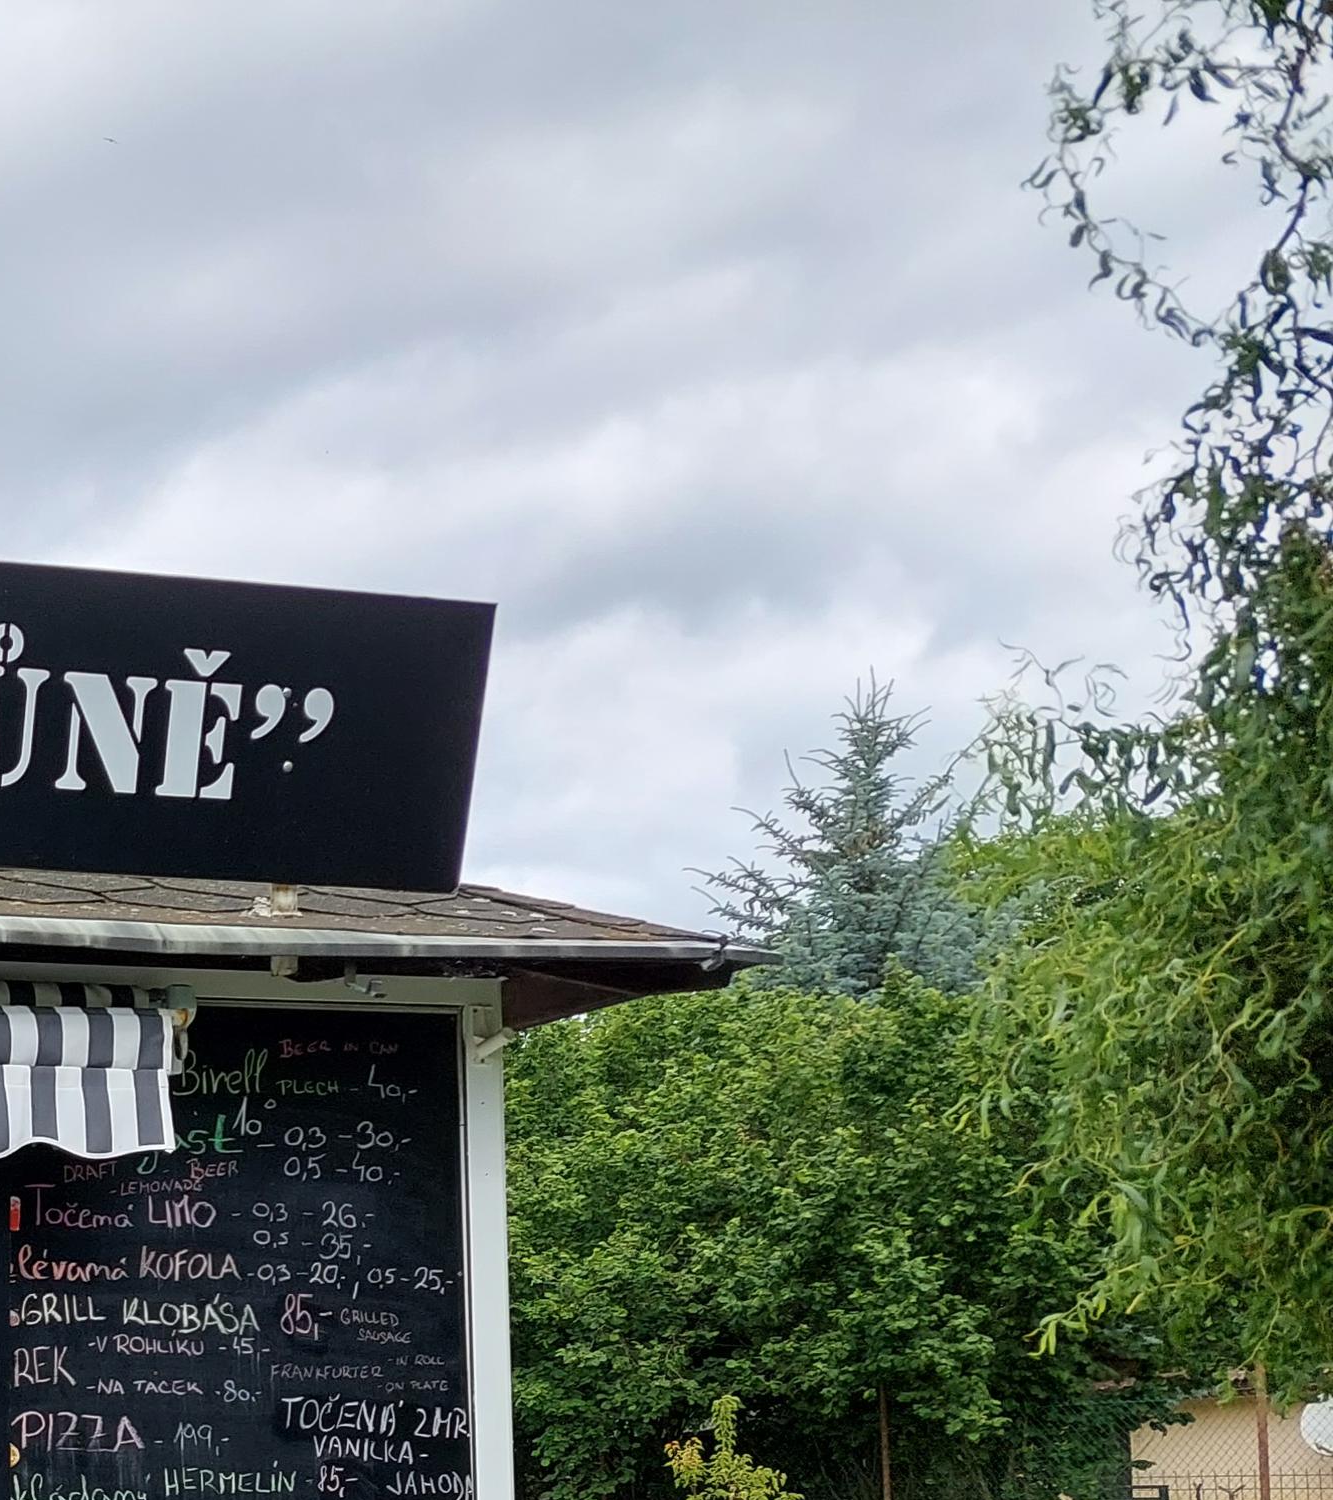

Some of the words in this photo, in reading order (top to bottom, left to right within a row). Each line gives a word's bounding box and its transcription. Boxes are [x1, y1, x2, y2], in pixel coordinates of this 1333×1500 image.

[279, 1039, 331, 1059] BEER
[173, 1048, 269, 1096] Birell
[275, 1078, 340, 1096] PLECH
[284, 1126, 328, 1152] 0,3
[63, 1164, 116, 1184] DRAFT
[186, 1159, 240, 1180] BEER
[284, 1156, 324, 1182] 0,5
[148, 1196, 217, 1230] LIMO
[17, 1245, 129, 1282] lévaná
[139, 1246, 243, 1282] KOFOLA
[21, 1293, 107, 1326] GRILL
[123, 1293, 260, 1335] KLOBÁSA
[341, 1308, 399, 1326] GRILLED
[270, 1363, 383, 1381] FRANKFURTER
[414, 1355, 445, 1365] ROLL
[281, 1395, 405, 1432] TOČENÁ
[11, 1411, 145, 1452] PIZZA
[164, 1459, 297, 1496] HERMELÍN
